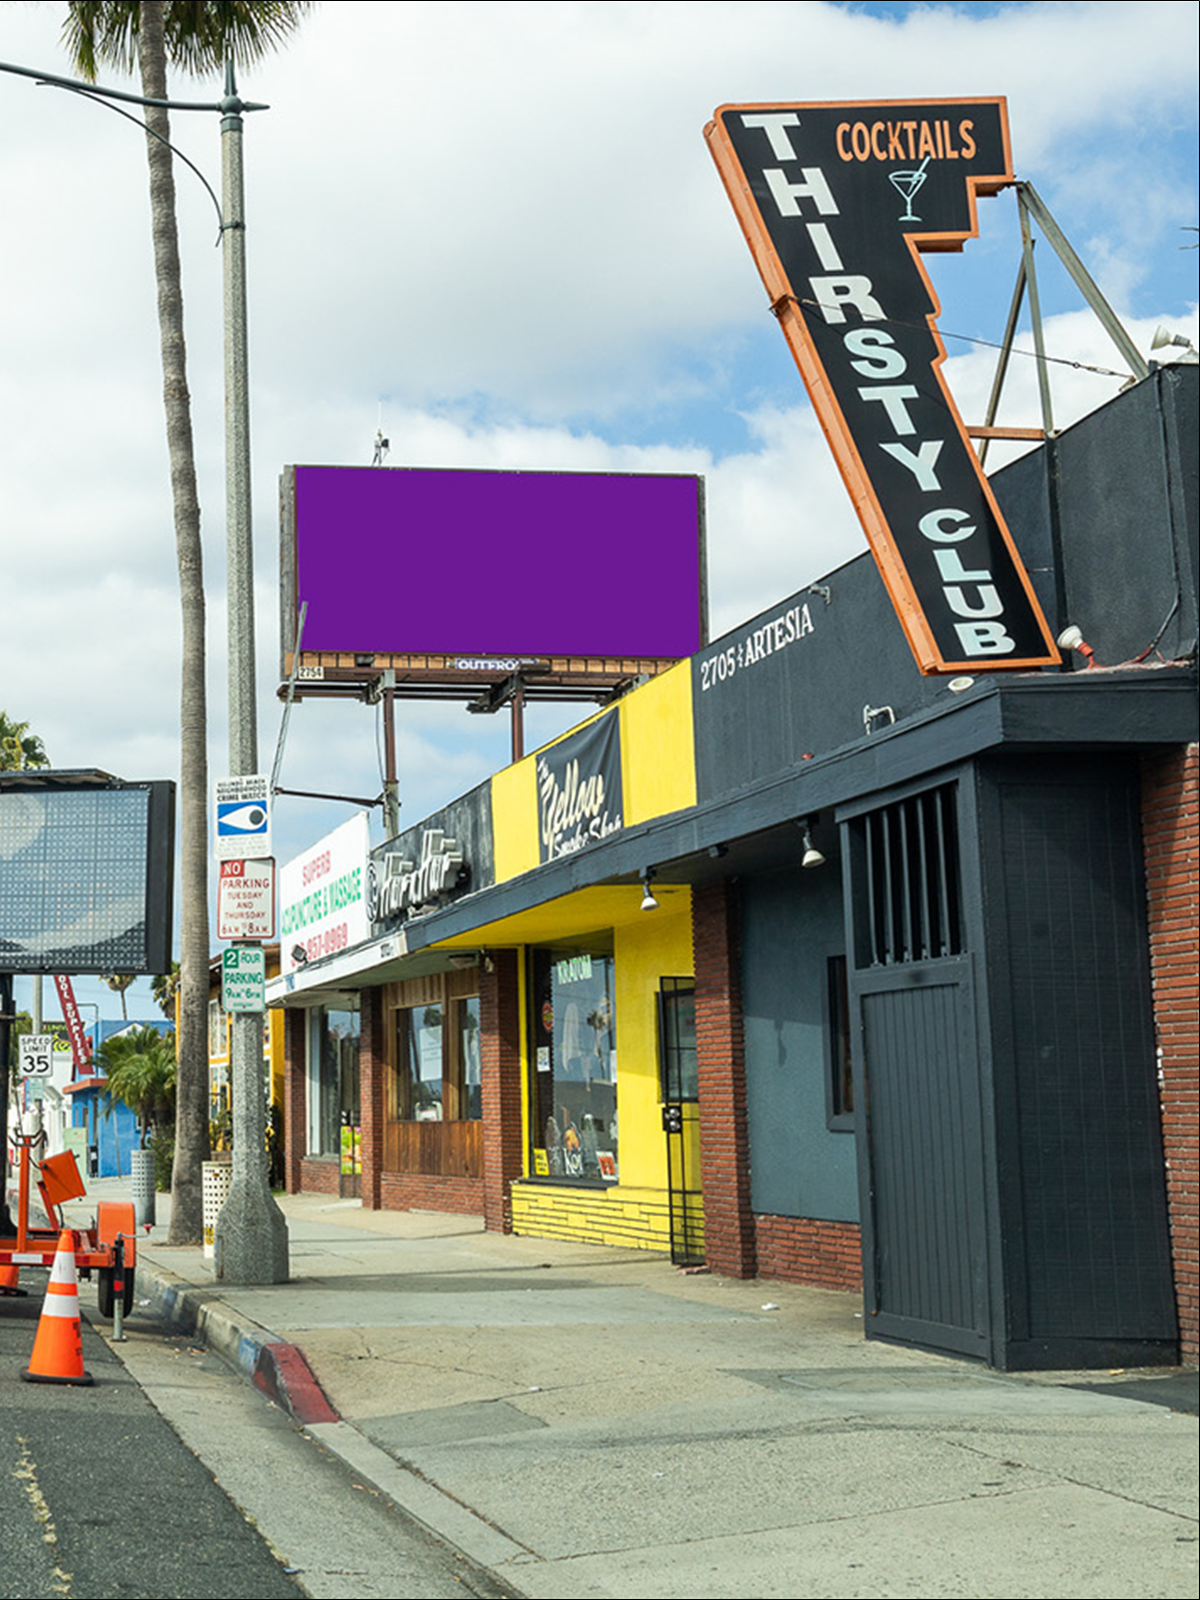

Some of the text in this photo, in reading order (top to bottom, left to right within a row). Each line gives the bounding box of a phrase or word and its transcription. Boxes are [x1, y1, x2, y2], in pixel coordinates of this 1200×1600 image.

[835, 119, 977, 162] COCKTAILS
[740, 112, 1016, 657] THIRSTY CLUB
[700, 646, 736, 692] 2705
[744, 602, 815, 667] ARTESIA
[458, 659, 539, 671] OUTFRO
[540, 758, 606, 862] Yellow
[223, 862, 241, 875] NO
[222, 878, 270, 890] PARKING
[227, 890, 263, 900] TUESDAY
[235, 901, 254, 910] AND
[224, 910, 266, 920] THURSDAY
[226, 951, 261, 966] 2 HOUR
[224, 972, 263, 985] PARKING
[58, 975, 87, 1065] OOL SUPPLIES
[21, 1037, 51, 1046] SPEED
[23, 1045, 48, 1053] LIMIT
[23, 1055, 49, 1073] 35
